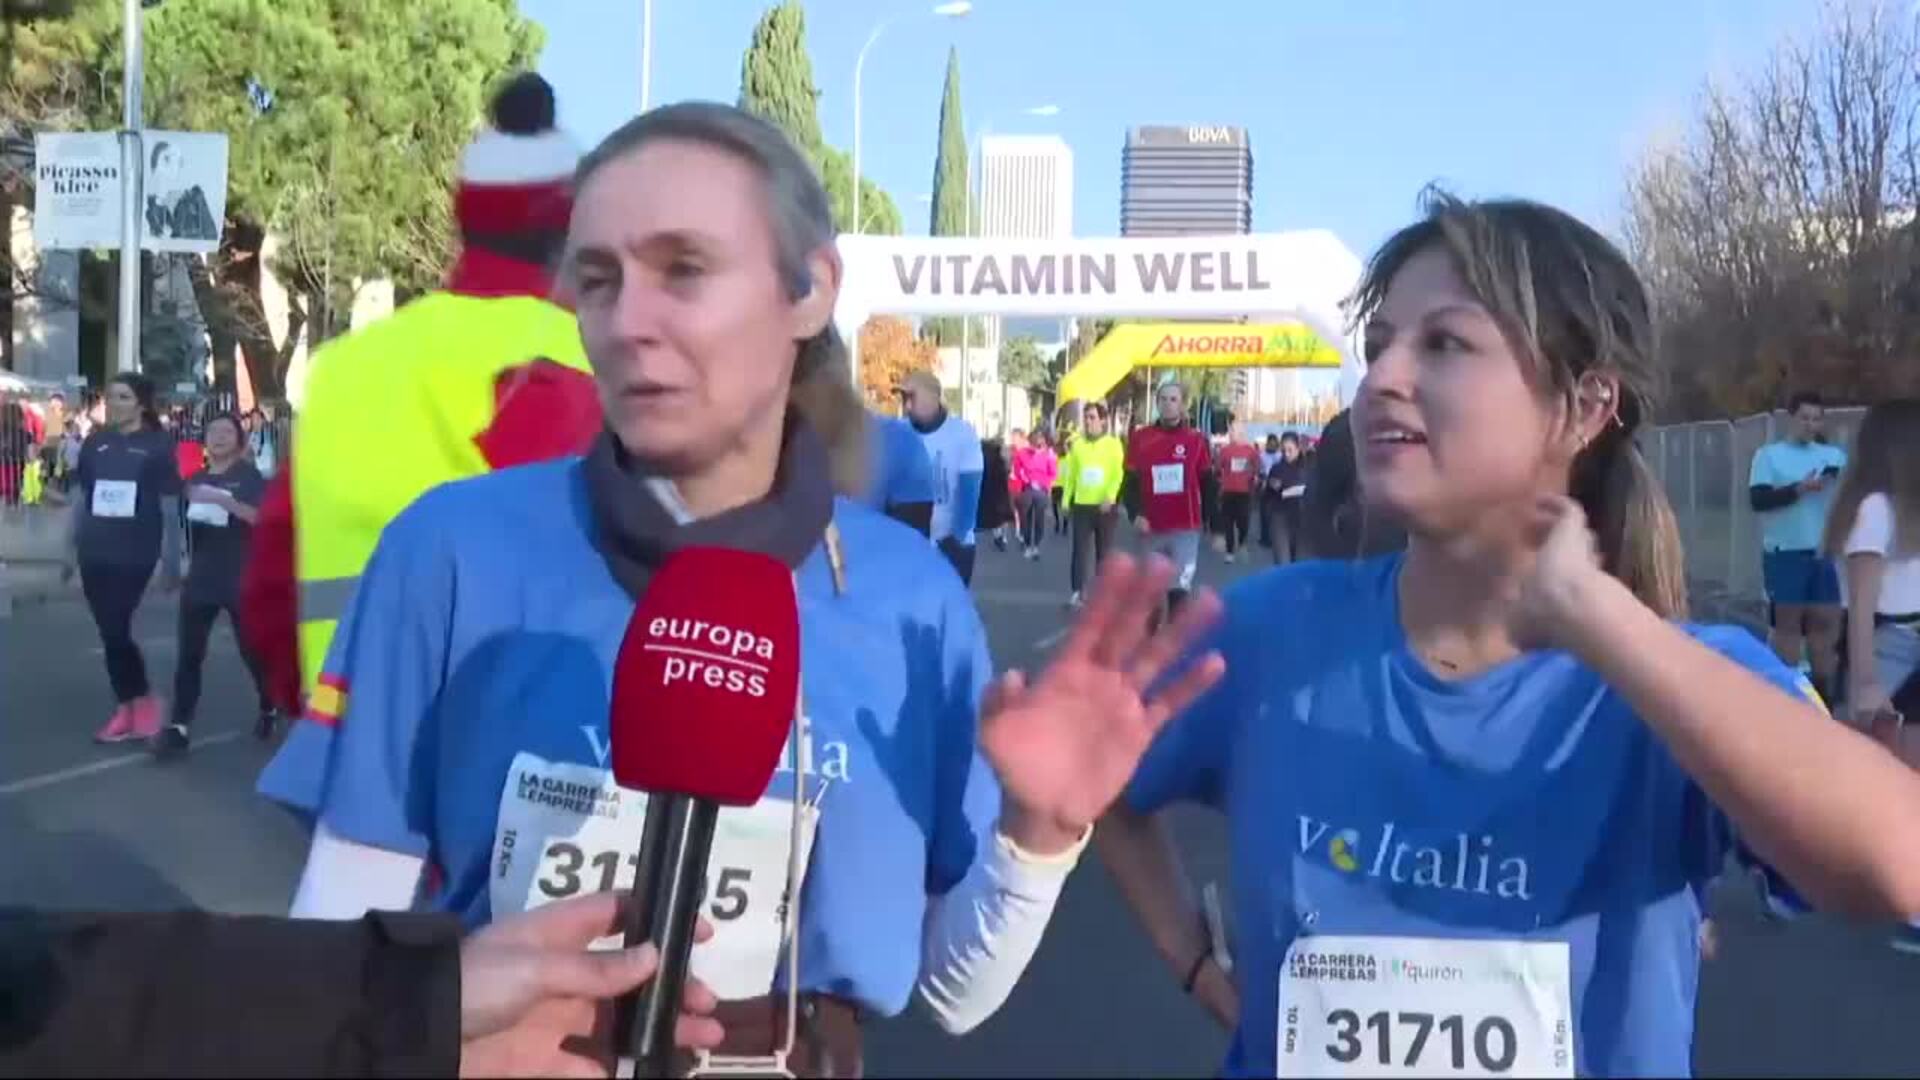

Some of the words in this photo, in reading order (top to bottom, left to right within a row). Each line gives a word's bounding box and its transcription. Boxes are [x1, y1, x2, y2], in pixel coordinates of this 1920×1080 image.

[892, 253, 1117, 296] VITAMIN
[1134, 250, 1271, 293] WELL
[648, 615, 775, 659] europa
[663, 654, 768, 698] press
[538, 842, 752, 922] 315
[1299, 966, 1376, 981] EMPRESAS
[1308, 953, 1376, 968] CARRERA
[1325, 1008, 1518, 1073] 31710
